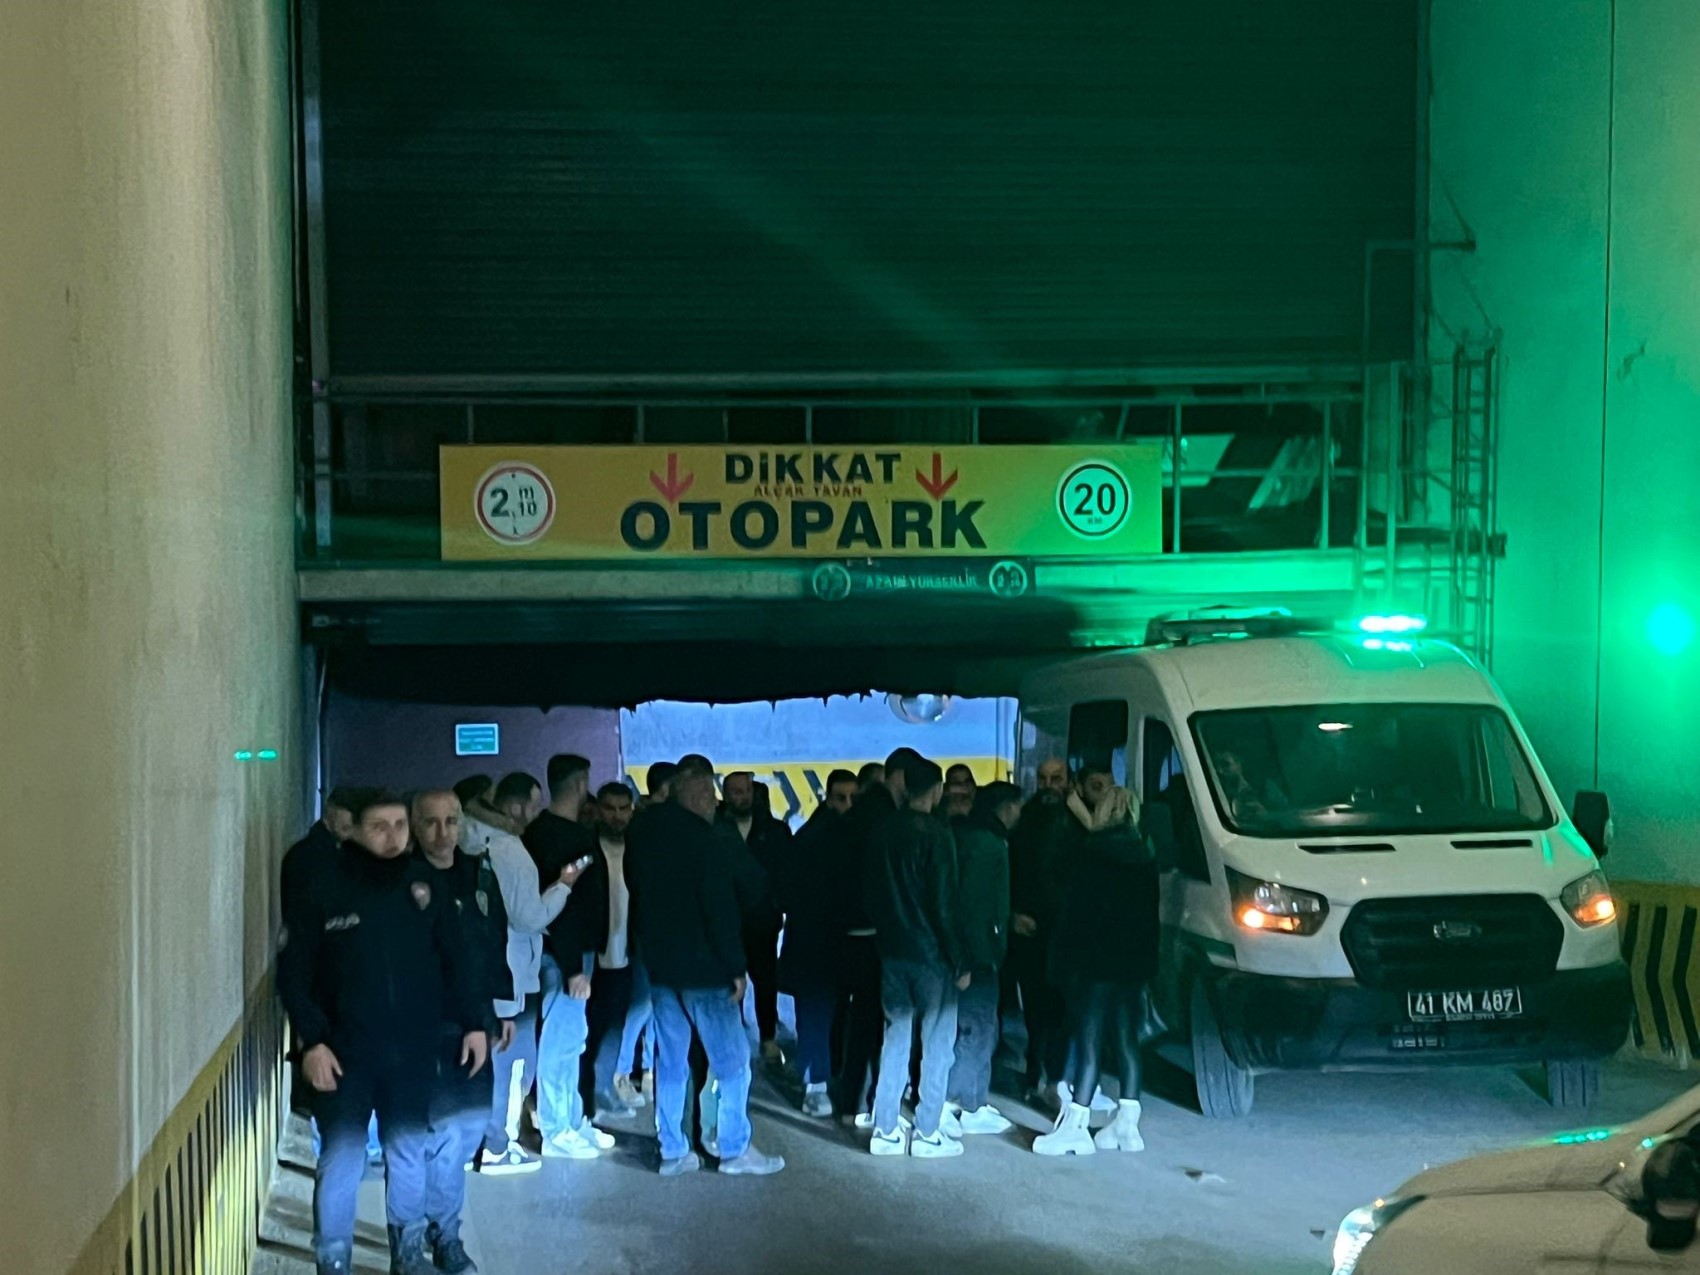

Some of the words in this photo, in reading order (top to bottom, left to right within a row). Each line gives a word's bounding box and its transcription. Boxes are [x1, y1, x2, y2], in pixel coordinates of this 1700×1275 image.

[725, 452, 901, 484] DİKKAT
[490, 487, 509, 517] 2
[815, 484, 862, 497] TAVAN
[1074, 482, 1116, 516] 20
[520, 501, 537, 517] 10
[620, 500, 987, 550] OTOPARK
[1415, 992, 1434, 1015] 41
[1442, 990, 1473, 1014] KM
[1482, 988, 1513, 1012] 487
